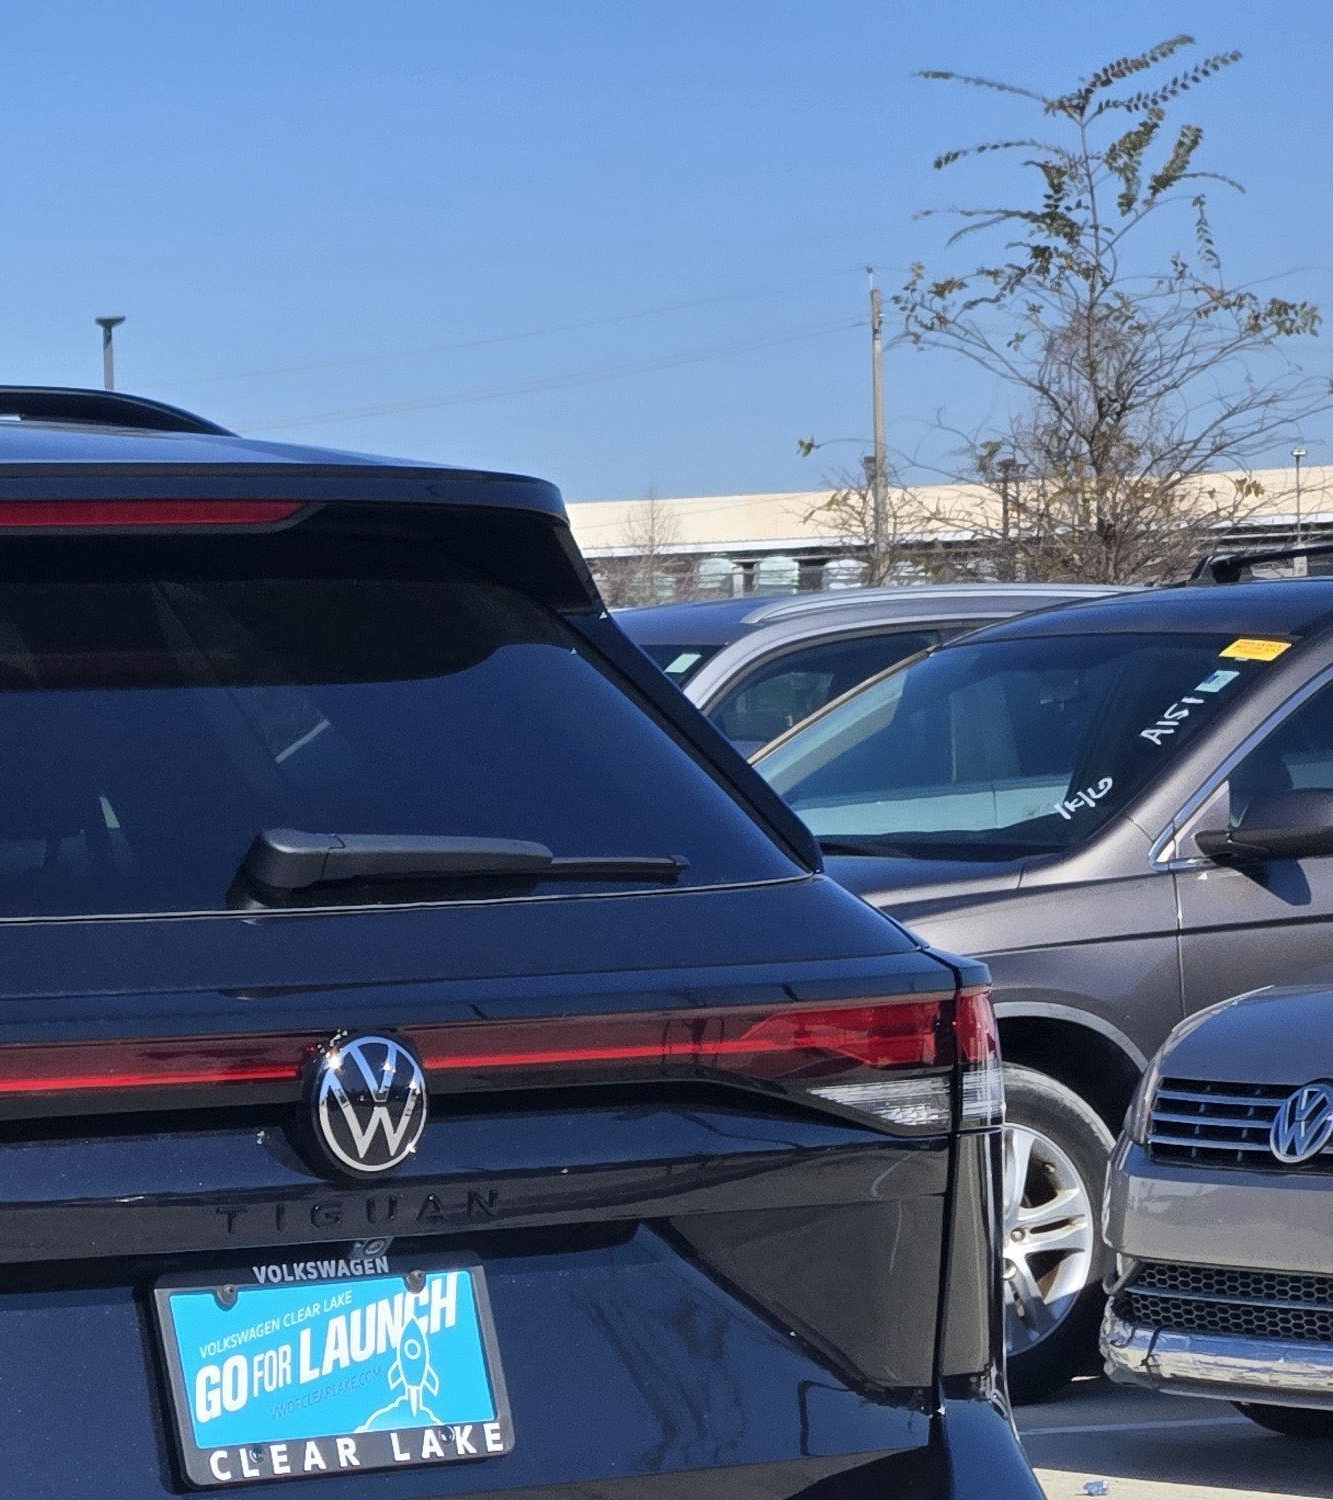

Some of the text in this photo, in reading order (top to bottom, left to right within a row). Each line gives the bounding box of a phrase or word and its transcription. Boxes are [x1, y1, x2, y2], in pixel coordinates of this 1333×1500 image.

[318, 1035, 427, 1172] VW
[215, 1188, 500, 1236] TIGUAN
[252, 1255, 390, 1284] VOLKSWAGEN
[195, 1272, 459, 1423] GO FOR LAUNCH
[199, 1289, 353, 1359] VOLKSWAGEN CLEAR LAKE
[208, 1421, 505, 1481] CLEAR LAKE
